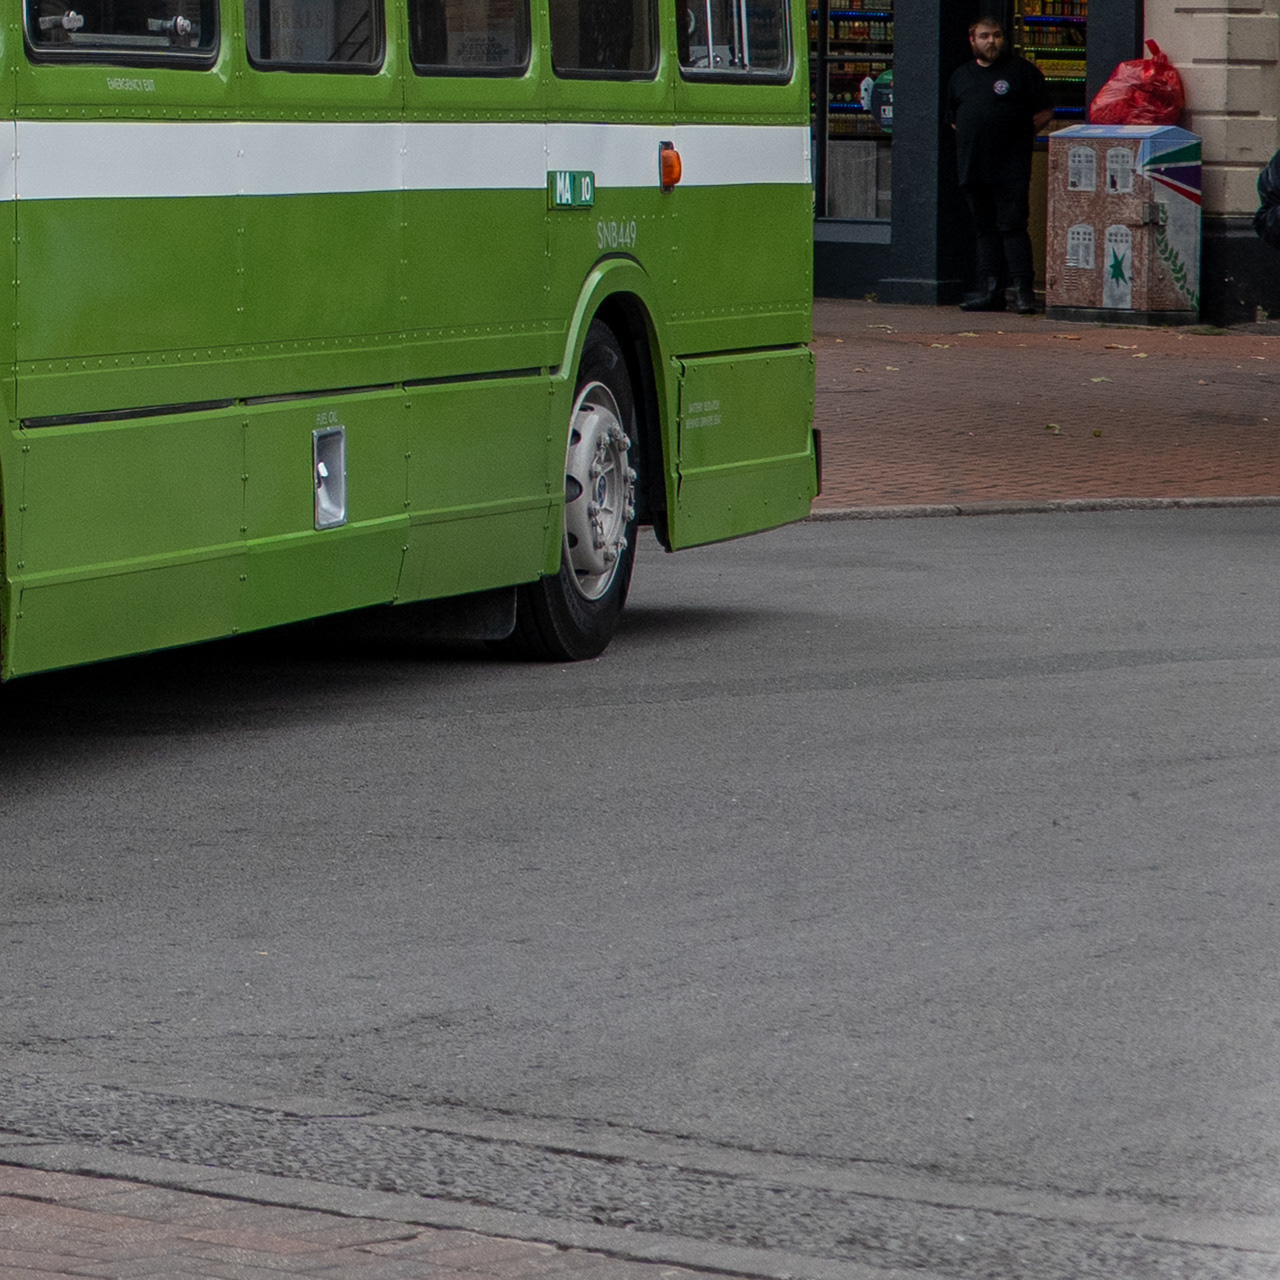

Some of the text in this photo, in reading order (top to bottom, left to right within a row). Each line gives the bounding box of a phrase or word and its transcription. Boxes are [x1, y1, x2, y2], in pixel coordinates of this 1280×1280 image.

[556, 171, 592, 205] MA 10
[596, 220, 637, 250] SNB449
